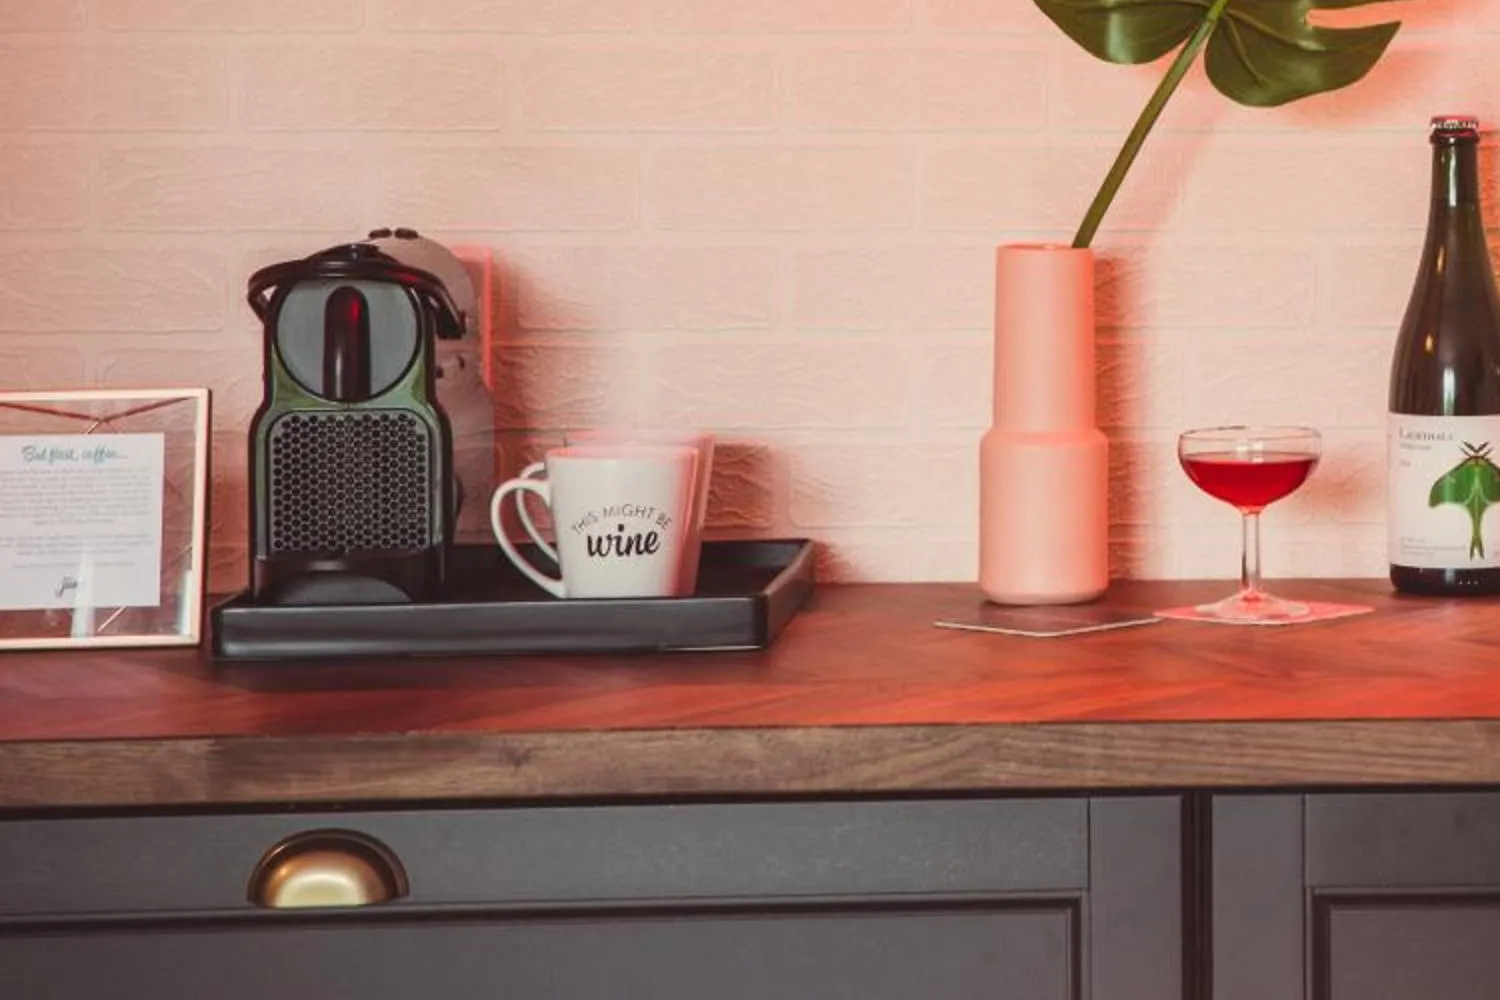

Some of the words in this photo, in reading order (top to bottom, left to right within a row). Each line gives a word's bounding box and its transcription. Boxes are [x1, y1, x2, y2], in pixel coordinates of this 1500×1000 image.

[570, 511, 599, 534] THIS
[602, 503, 656, 519] MIGHT
[655, 511, 673, 531] BE
[587, 523, 661, 558] wine
